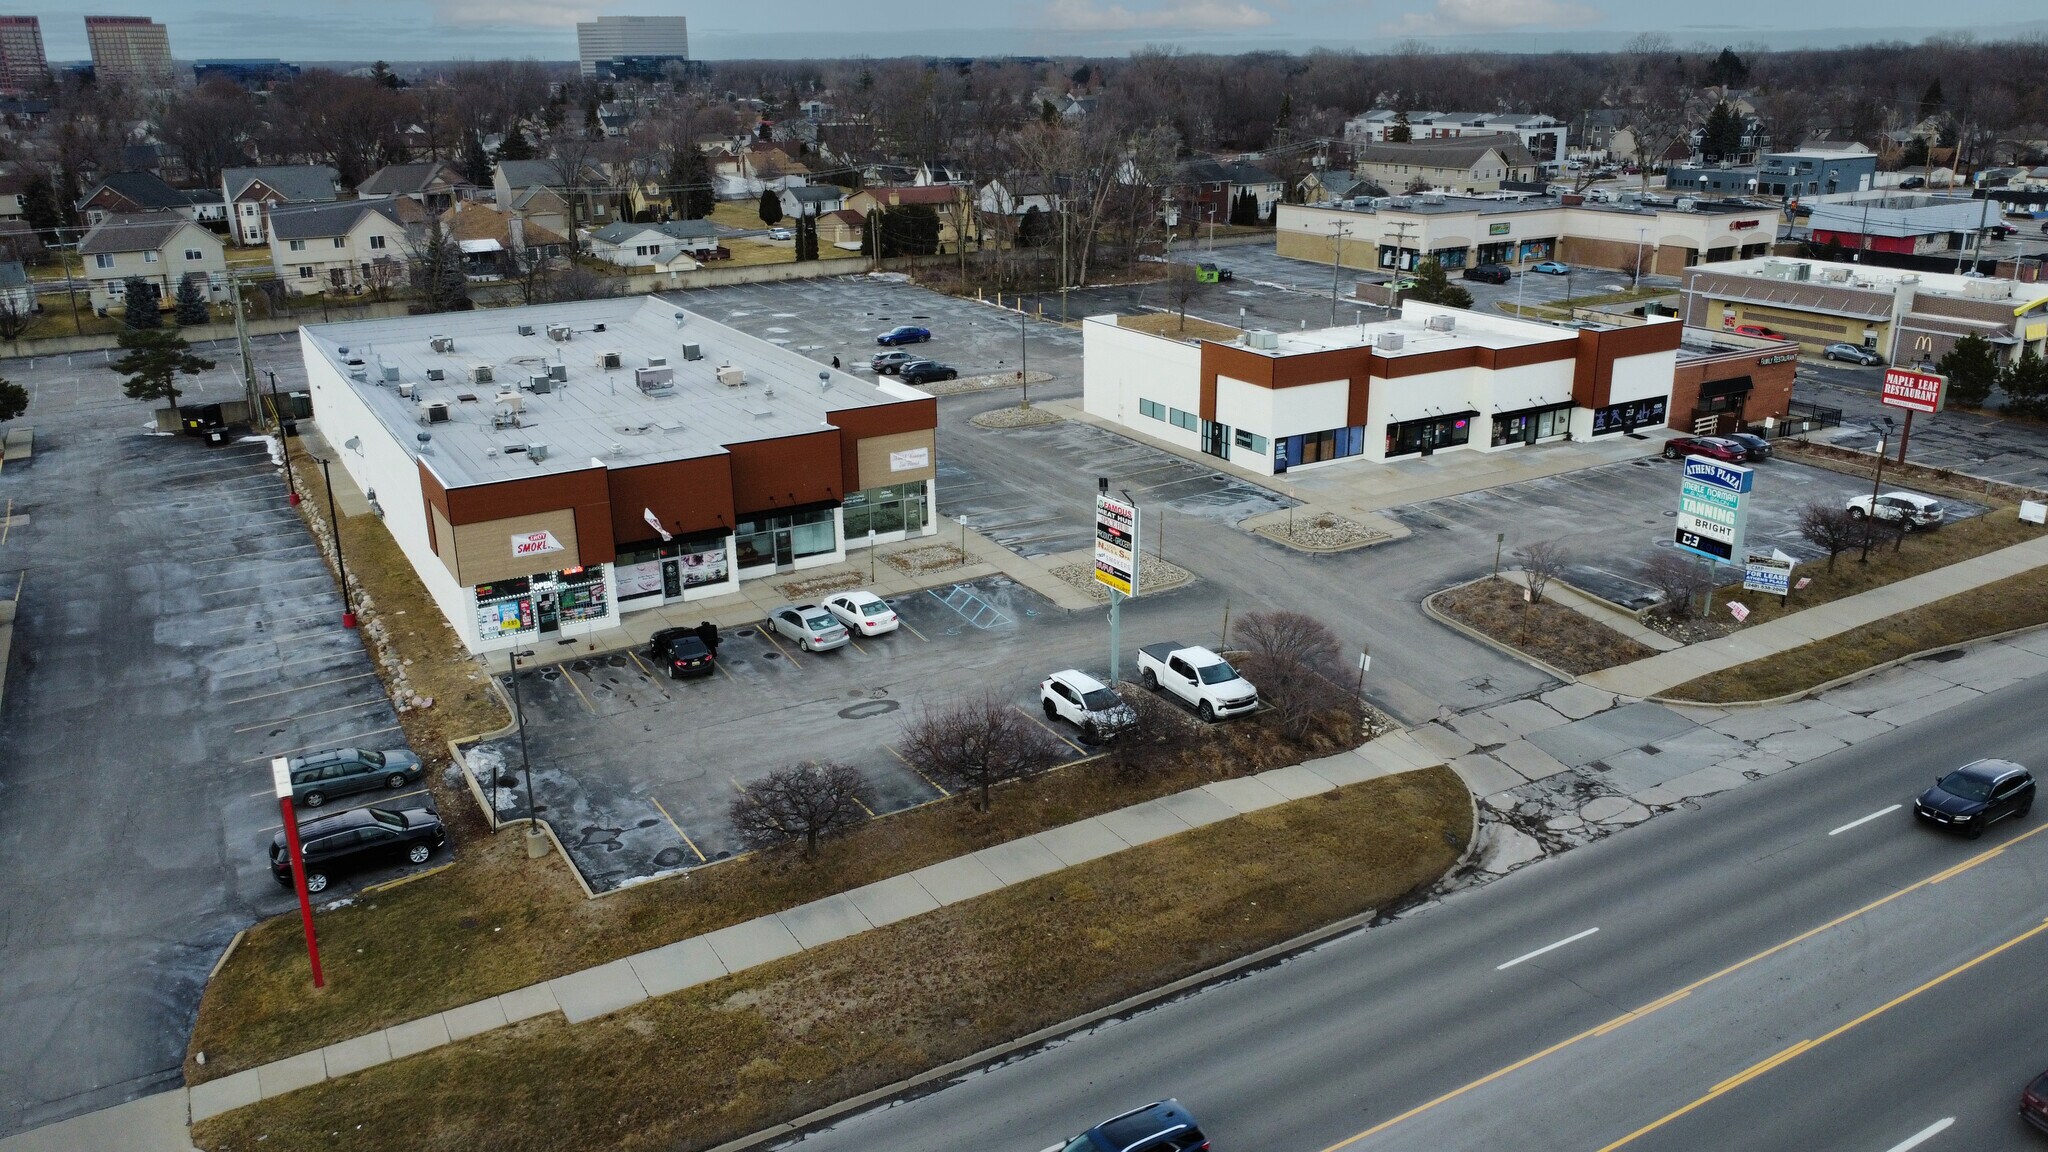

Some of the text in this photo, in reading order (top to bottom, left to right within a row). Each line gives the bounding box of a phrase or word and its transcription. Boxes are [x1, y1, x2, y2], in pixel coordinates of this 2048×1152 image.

[1886, 374, 1939, 392] MAPLE LEAF
[1884, 384, 1937, 402] RESTAURANT
[1686, 464, 1740, 489] ATHENS PLAZA
[1684, 482, 1738, 502] MERLE NORMAN
[1098, 508, 1132, 526] MEAT HUB
[1104, 502, 1132, 519] FAMOUS
[1683, 498, 1735, 524] TANNING
[1695, 518, 1732, 536] BRIGHT
[534, 580, 553, 590] OPEN
[1764, 572, 1788, 582] LEASE
